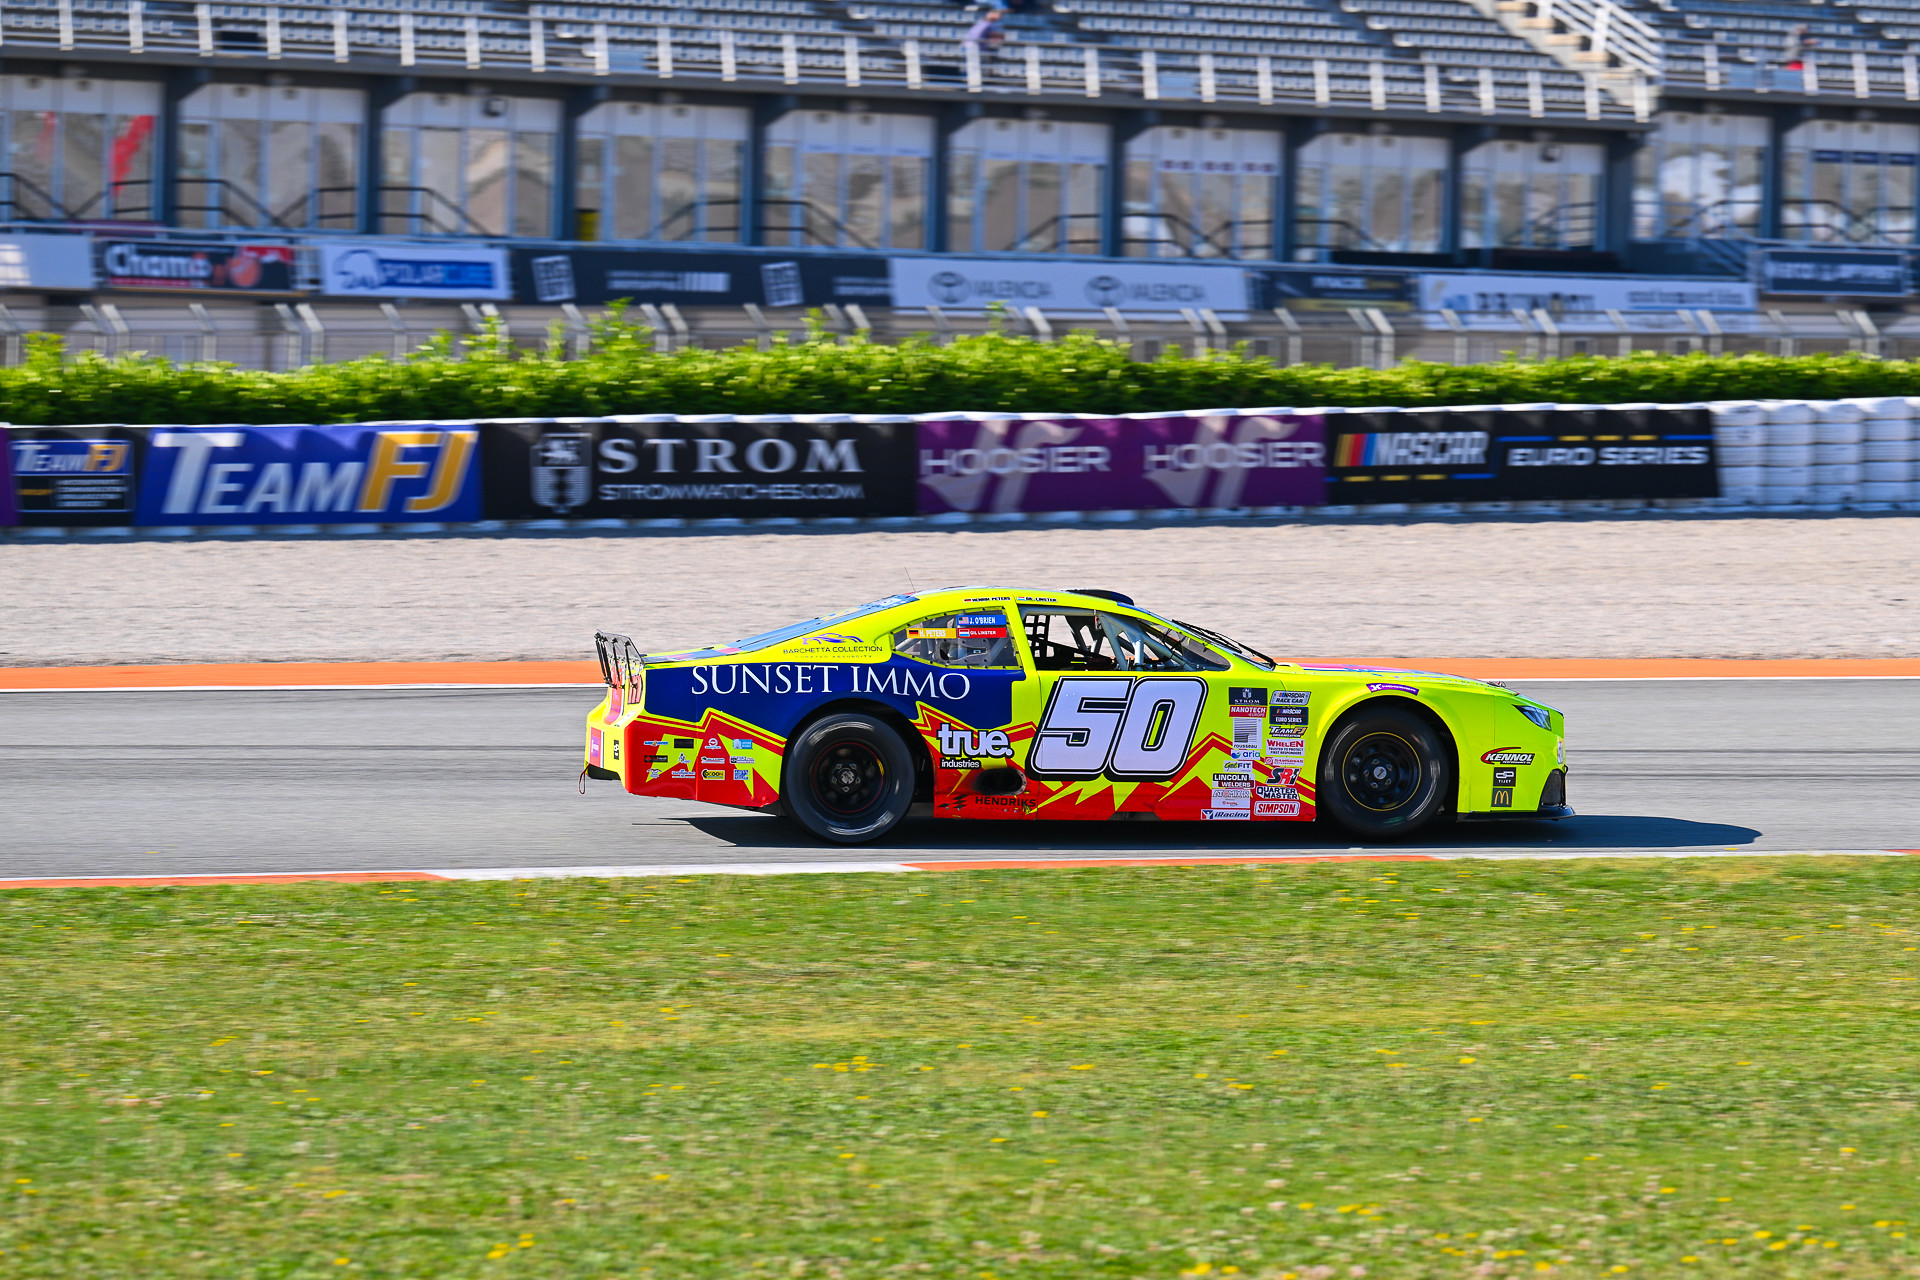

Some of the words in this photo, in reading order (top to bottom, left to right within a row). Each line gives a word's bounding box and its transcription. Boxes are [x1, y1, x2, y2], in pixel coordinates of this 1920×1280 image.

[599, 438, 866, 473] STROM
[1143, 442, 1327, 470] HOOSIER
[1374, 433, 1490, 466] NASCAR
[1506, 447, 1595, 466] EURO
[1598, 446, 1709, 465] SERIES
[919, 446, 1112, 475] HOOSIER
[926, 629, 946, 638] PETERS
[783, 646, 831, 654] BARCHETTA
[691, 664, 839, 695] SUNSET
[850, 665, 971, 700] IMMO
[1031, 675, 1208, 779] 50
[937, 723, 1014, 757] true.
[1243, 750, 1261, 758] aria
[1485, 753, 1533, 762] KENNOL
[941, 759, 980, 768] industries
[1256, 787, 1296, 795] QUARTER
[975, 796, 1037, 807] HENDRIKS
[1257, 803, 1296, 813] SIMPSON
